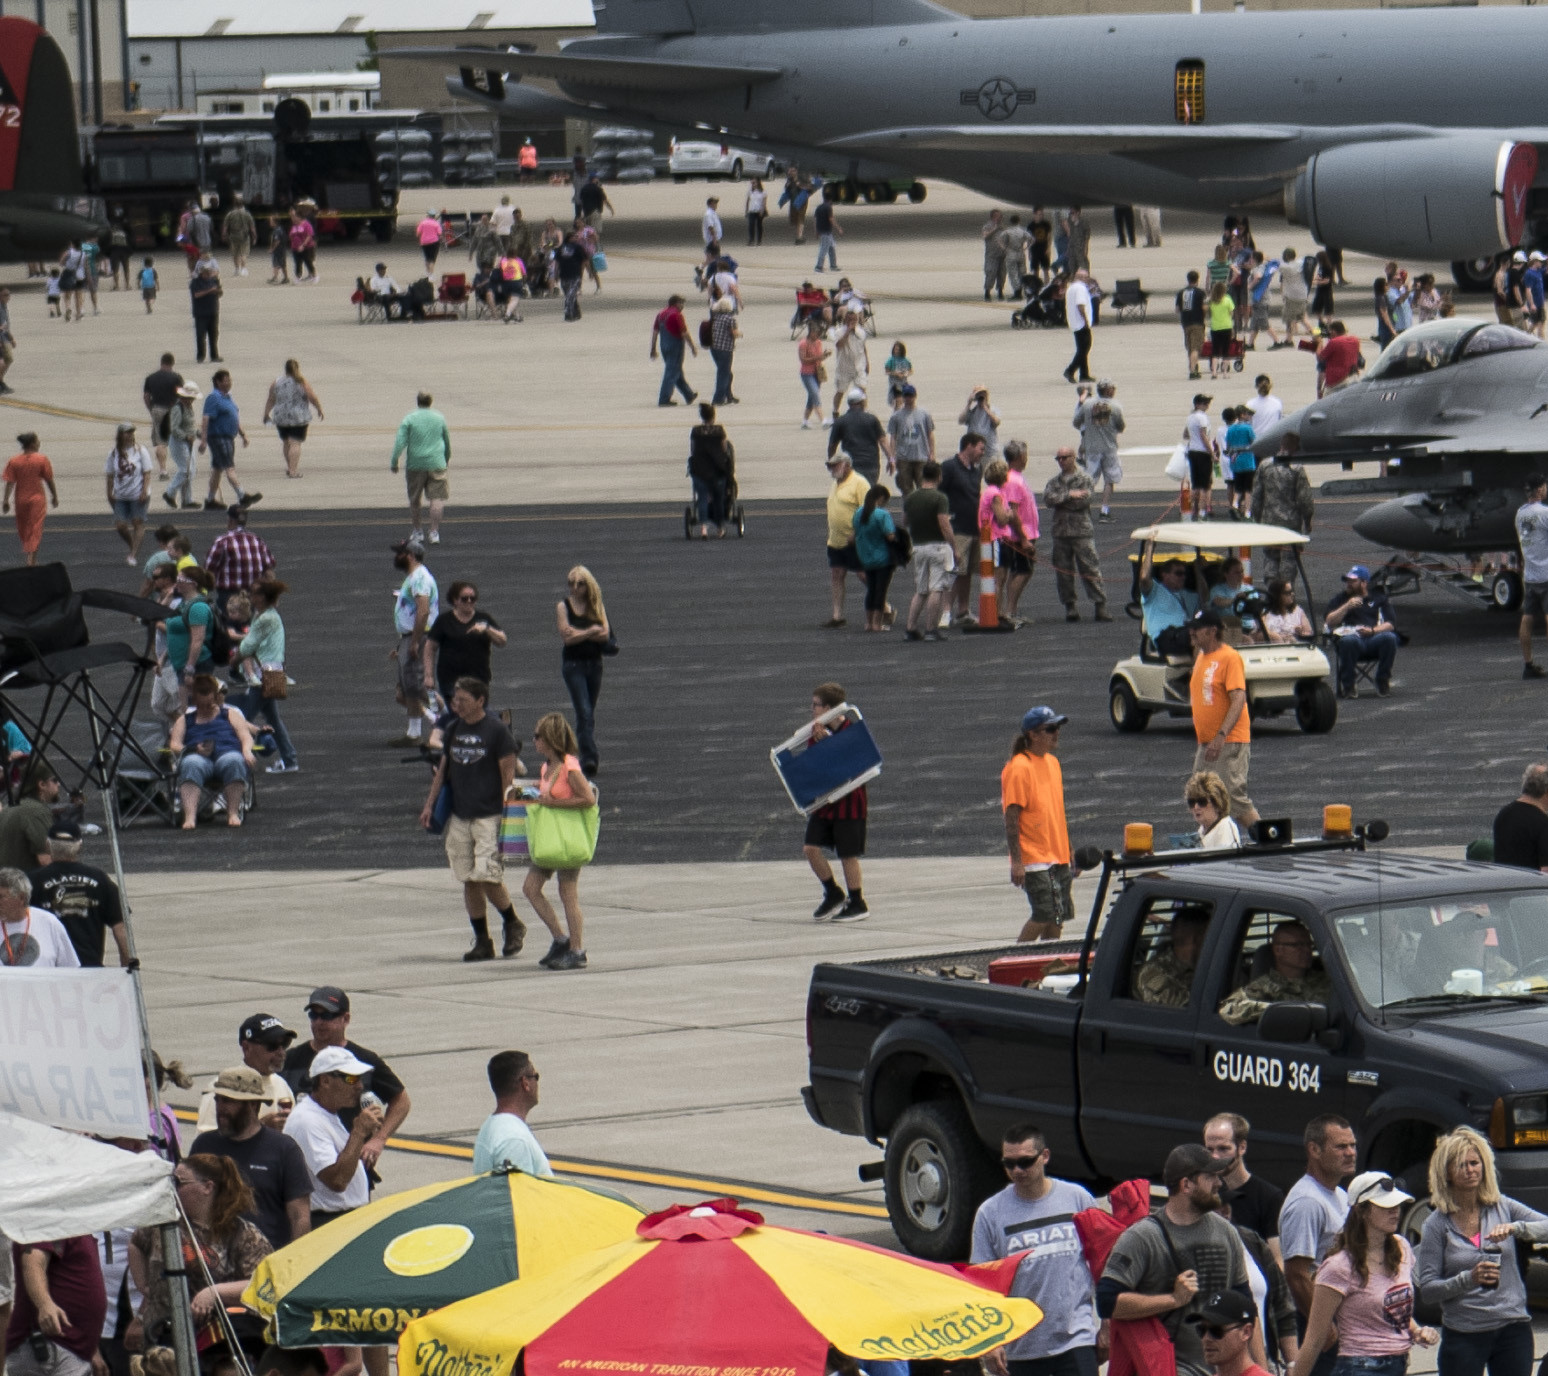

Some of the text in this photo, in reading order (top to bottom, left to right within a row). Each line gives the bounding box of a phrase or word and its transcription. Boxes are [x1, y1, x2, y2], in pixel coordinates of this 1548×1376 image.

[45, 875, 99, 889] GLACIER
[1213, 1050, 1321, 1093] GUARD 364
[1007, 1226, 1075, 1252] ARIAT
[861, 1304, 1003, 1355] Nathan's
[558, 1359, 577, 1369] AN
[582, 1360, 645, 1373] AMERICAN
[650, 1364, 717, 1376] TRADITION
